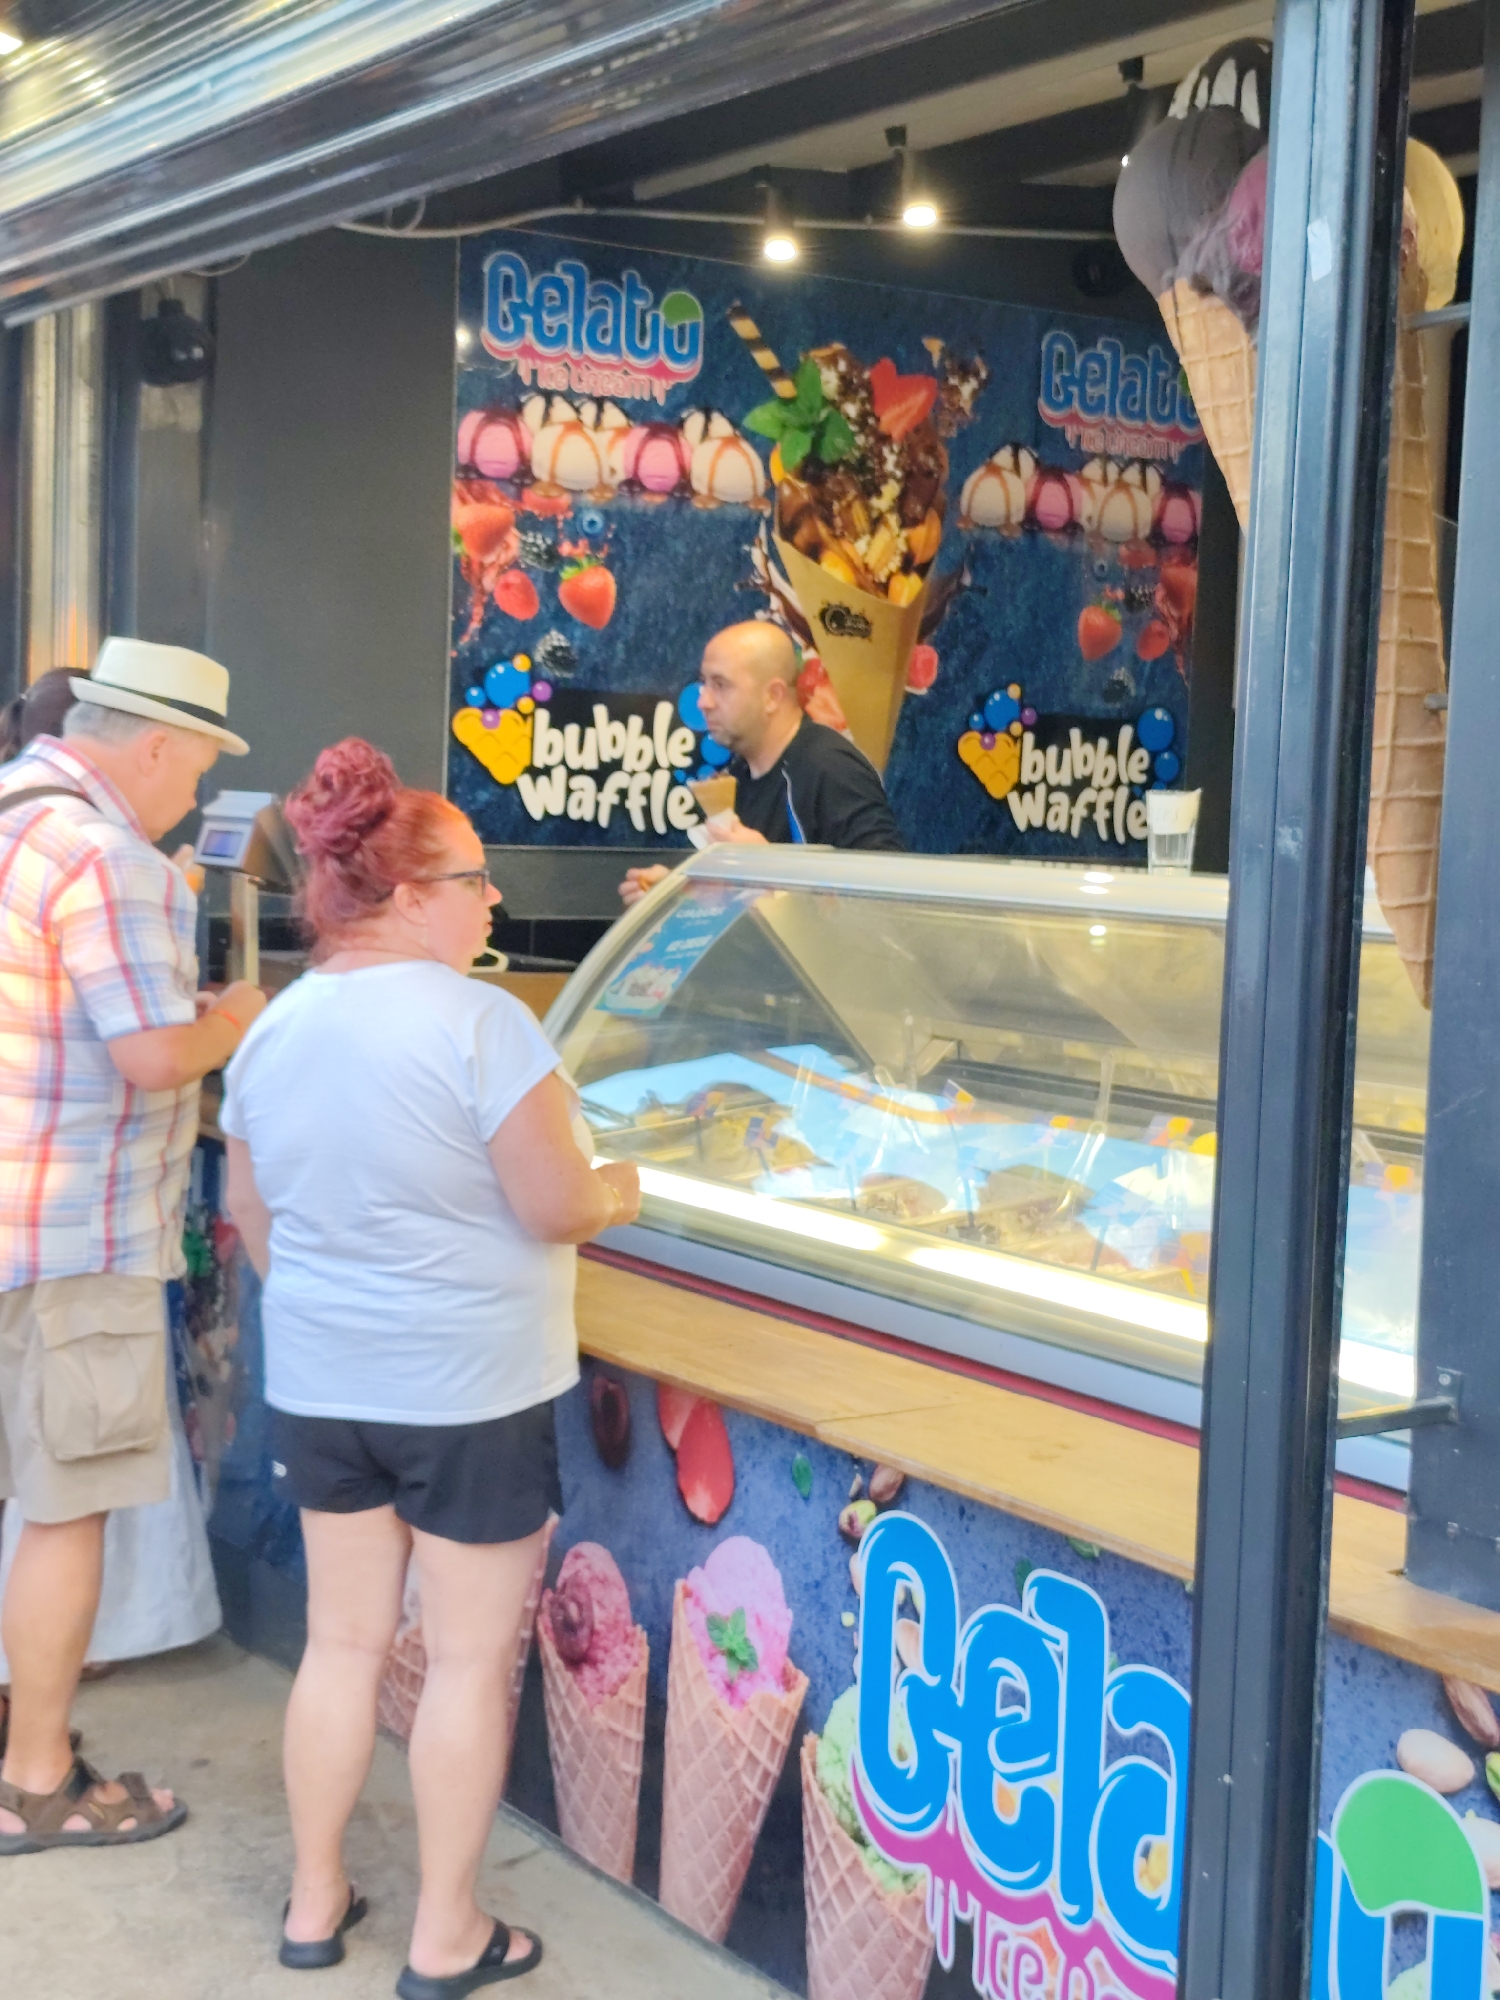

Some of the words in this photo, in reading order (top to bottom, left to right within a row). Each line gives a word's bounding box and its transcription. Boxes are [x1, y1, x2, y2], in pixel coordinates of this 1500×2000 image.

[483, 251, 704, 371] Gelato
[532, 700, 696, 772] bubble
[1020, 723, 1150, 788] bubble
